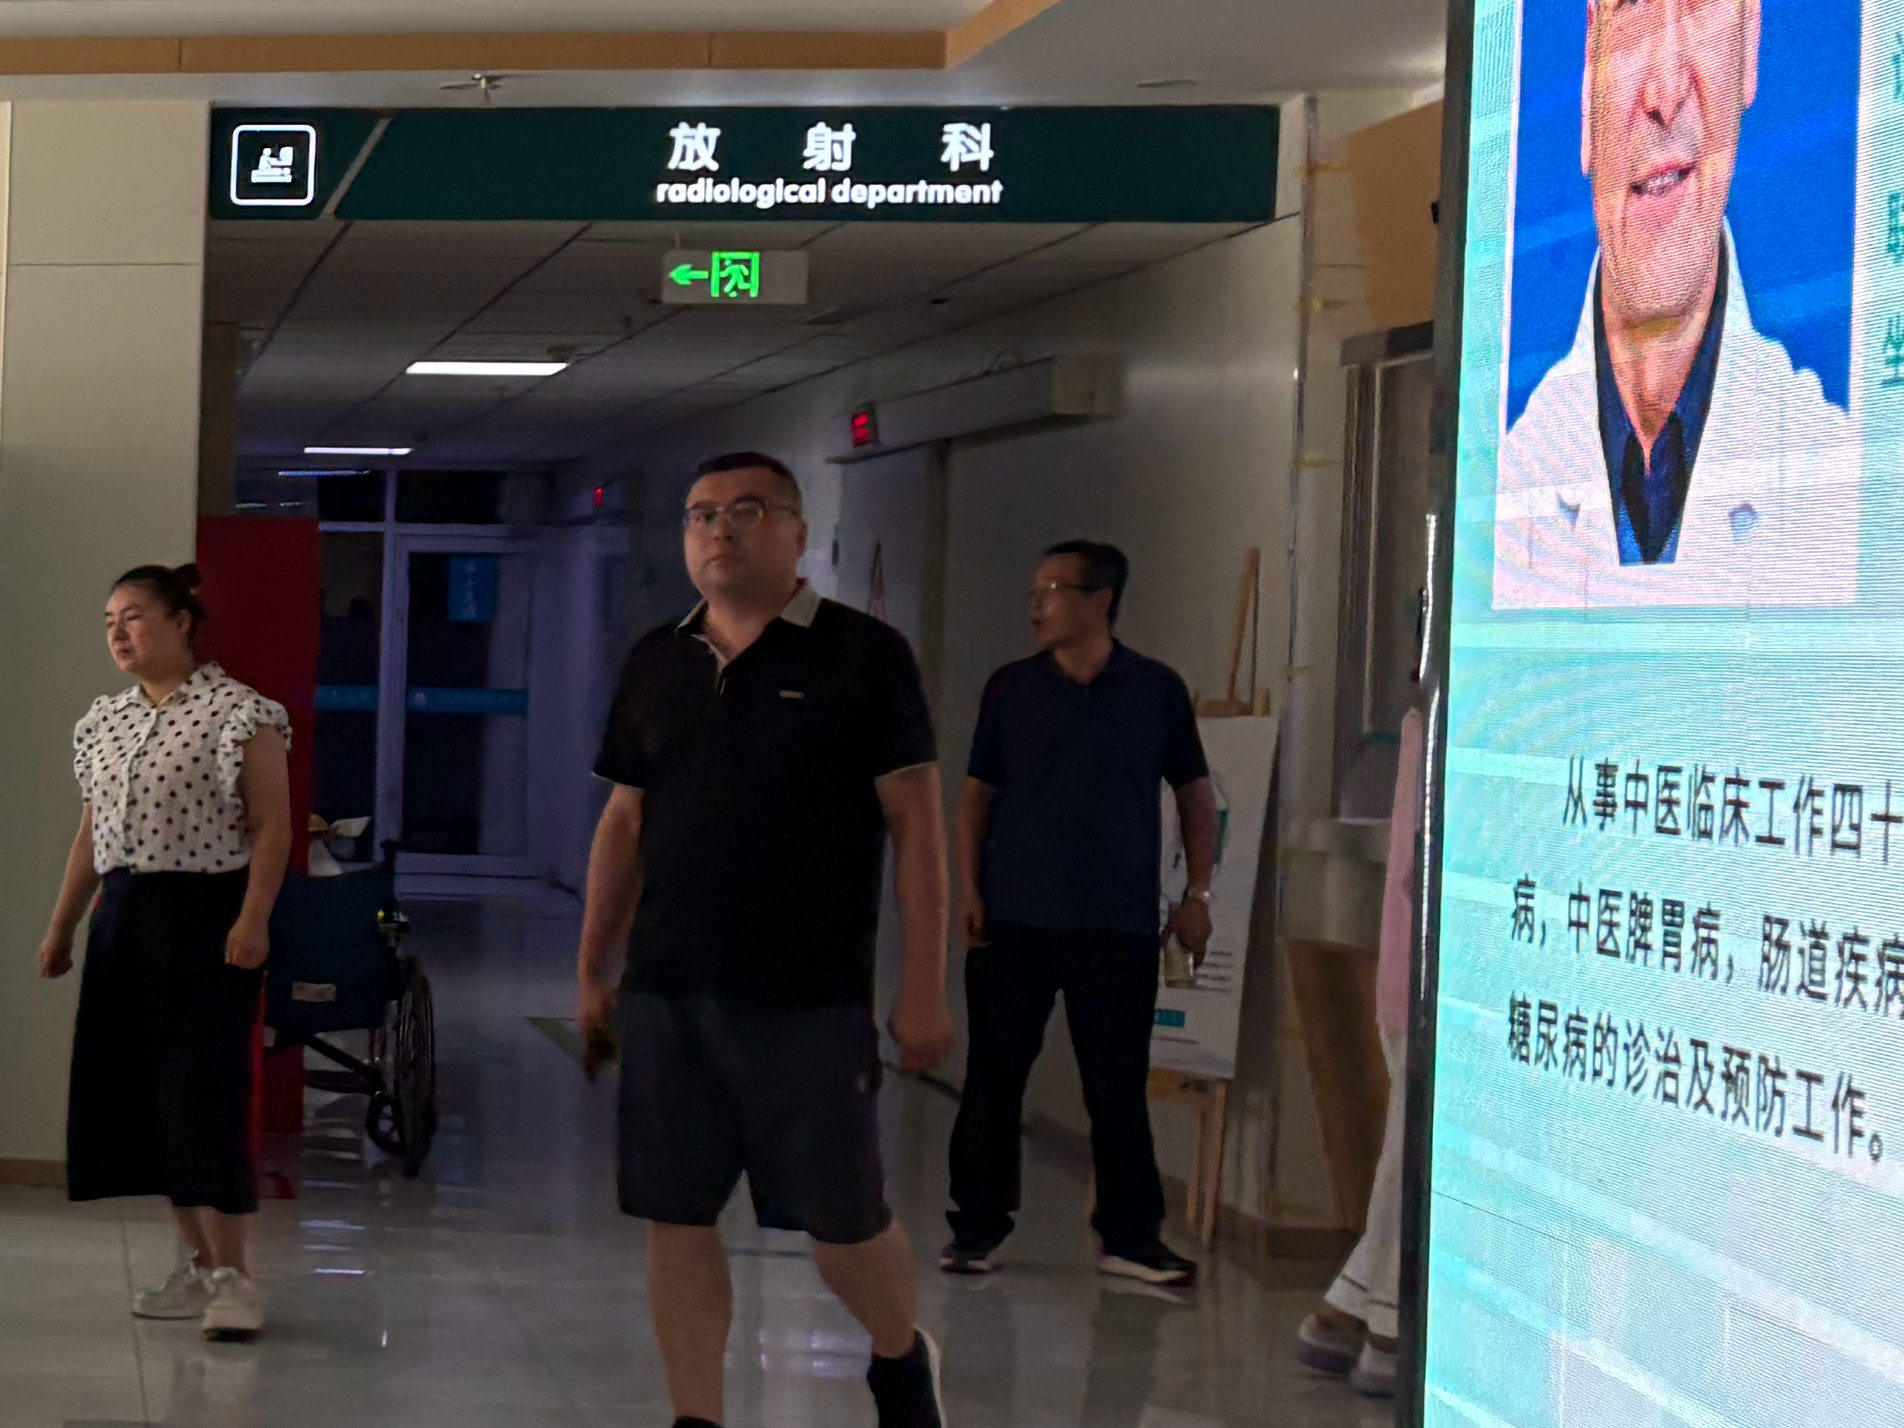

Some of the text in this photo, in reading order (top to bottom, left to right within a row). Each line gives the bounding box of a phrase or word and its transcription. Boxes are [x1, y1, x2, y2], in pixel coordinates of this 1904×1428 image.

[667, 121, 994, 172] 放射科
[656, 177, 1004, 209] radiological department
[1563, 755, 1904, 865] 从事中医临床工作四十
[1508, 990, 1883, 1162] 糖尿病的诊治及预防工作。
